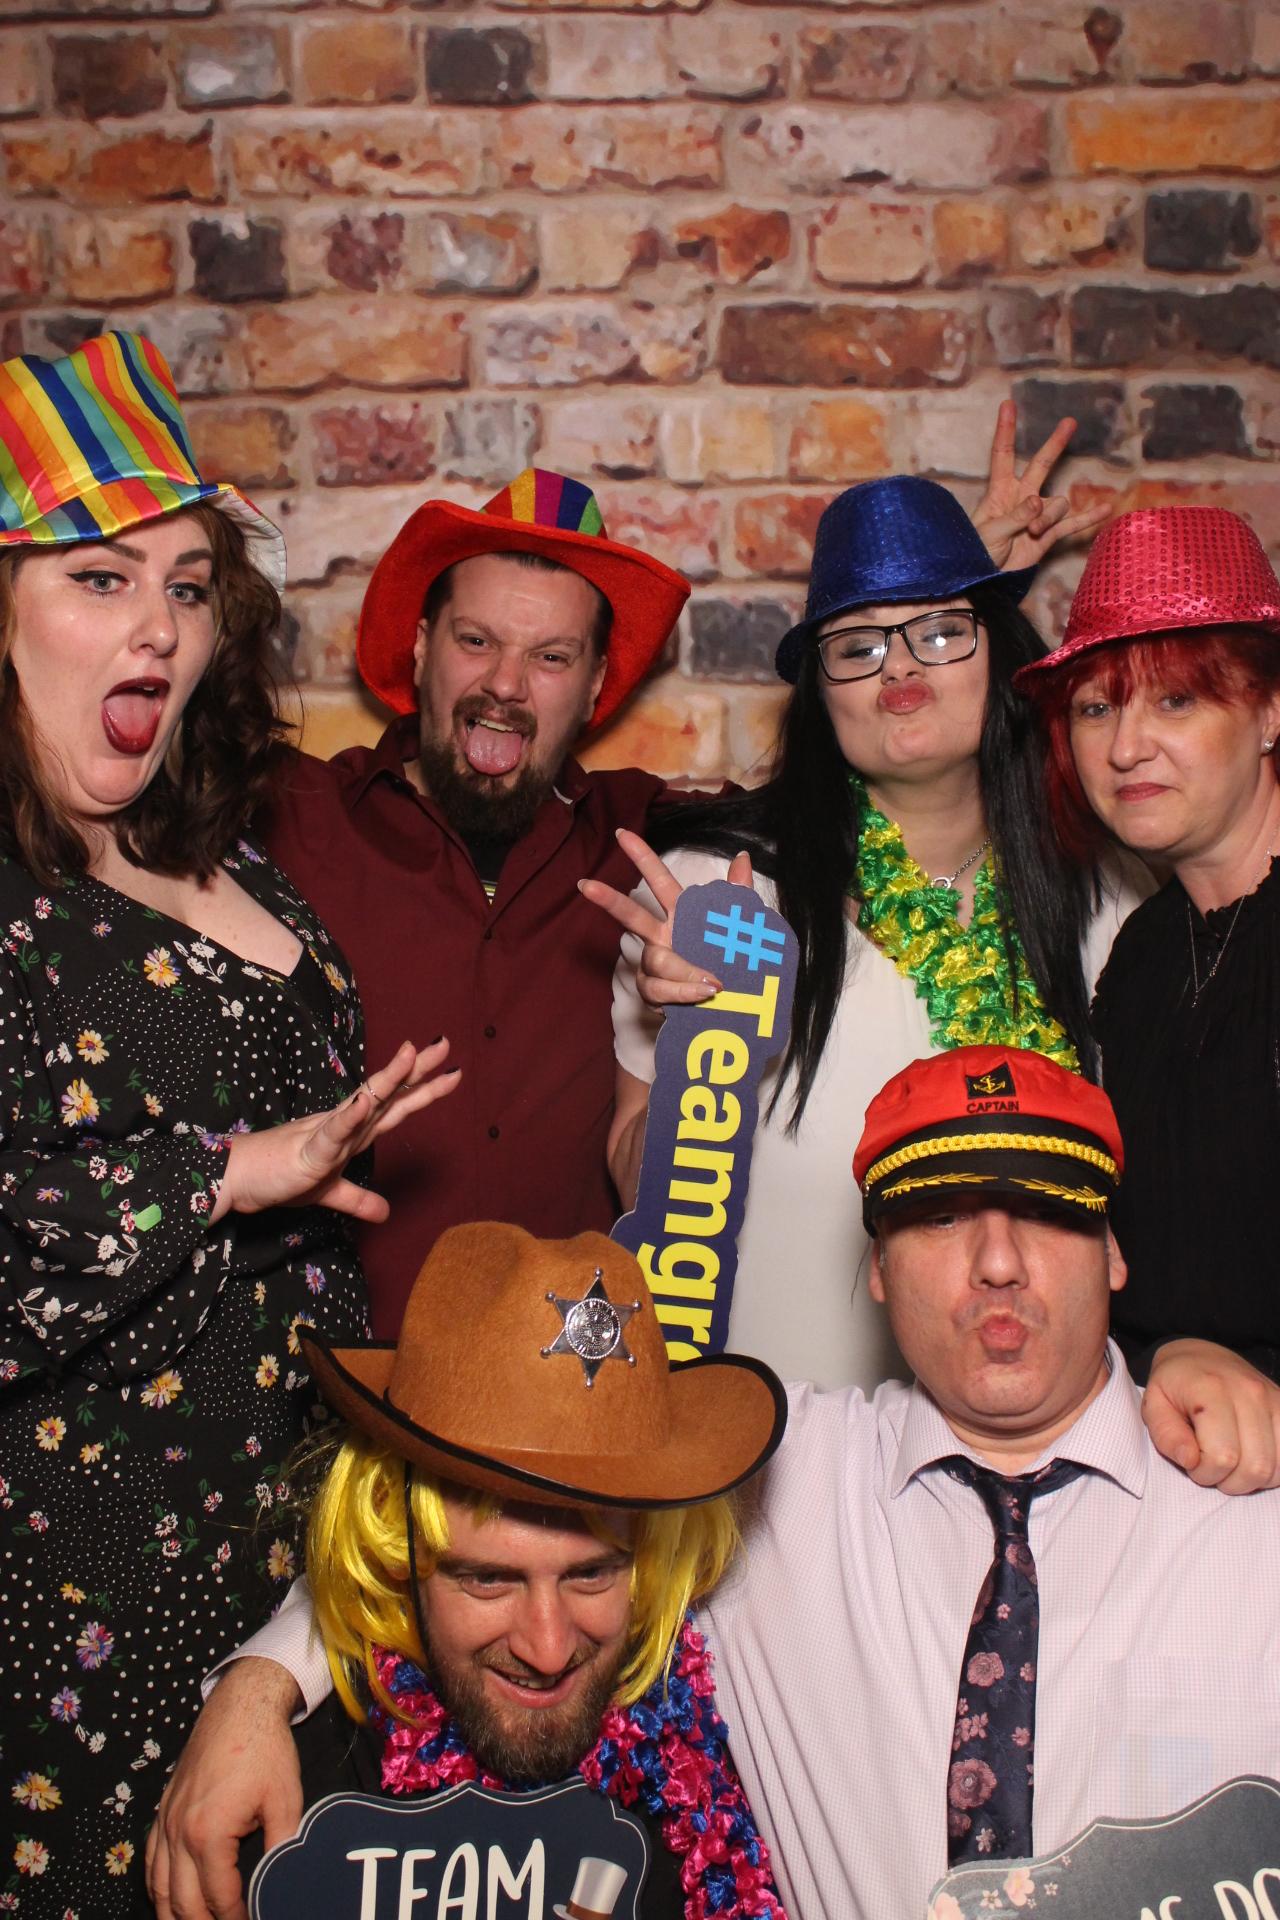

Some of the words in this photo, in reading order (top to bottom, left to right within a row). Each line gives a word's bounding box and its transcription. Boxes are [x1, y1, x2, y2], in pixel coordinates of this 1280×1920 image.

[636, 905, 786, 1362] #Teamgr
[966, 1101, 1020, 1114] CAPTAIN
[346, 1838, 545, 1920] TEAM
